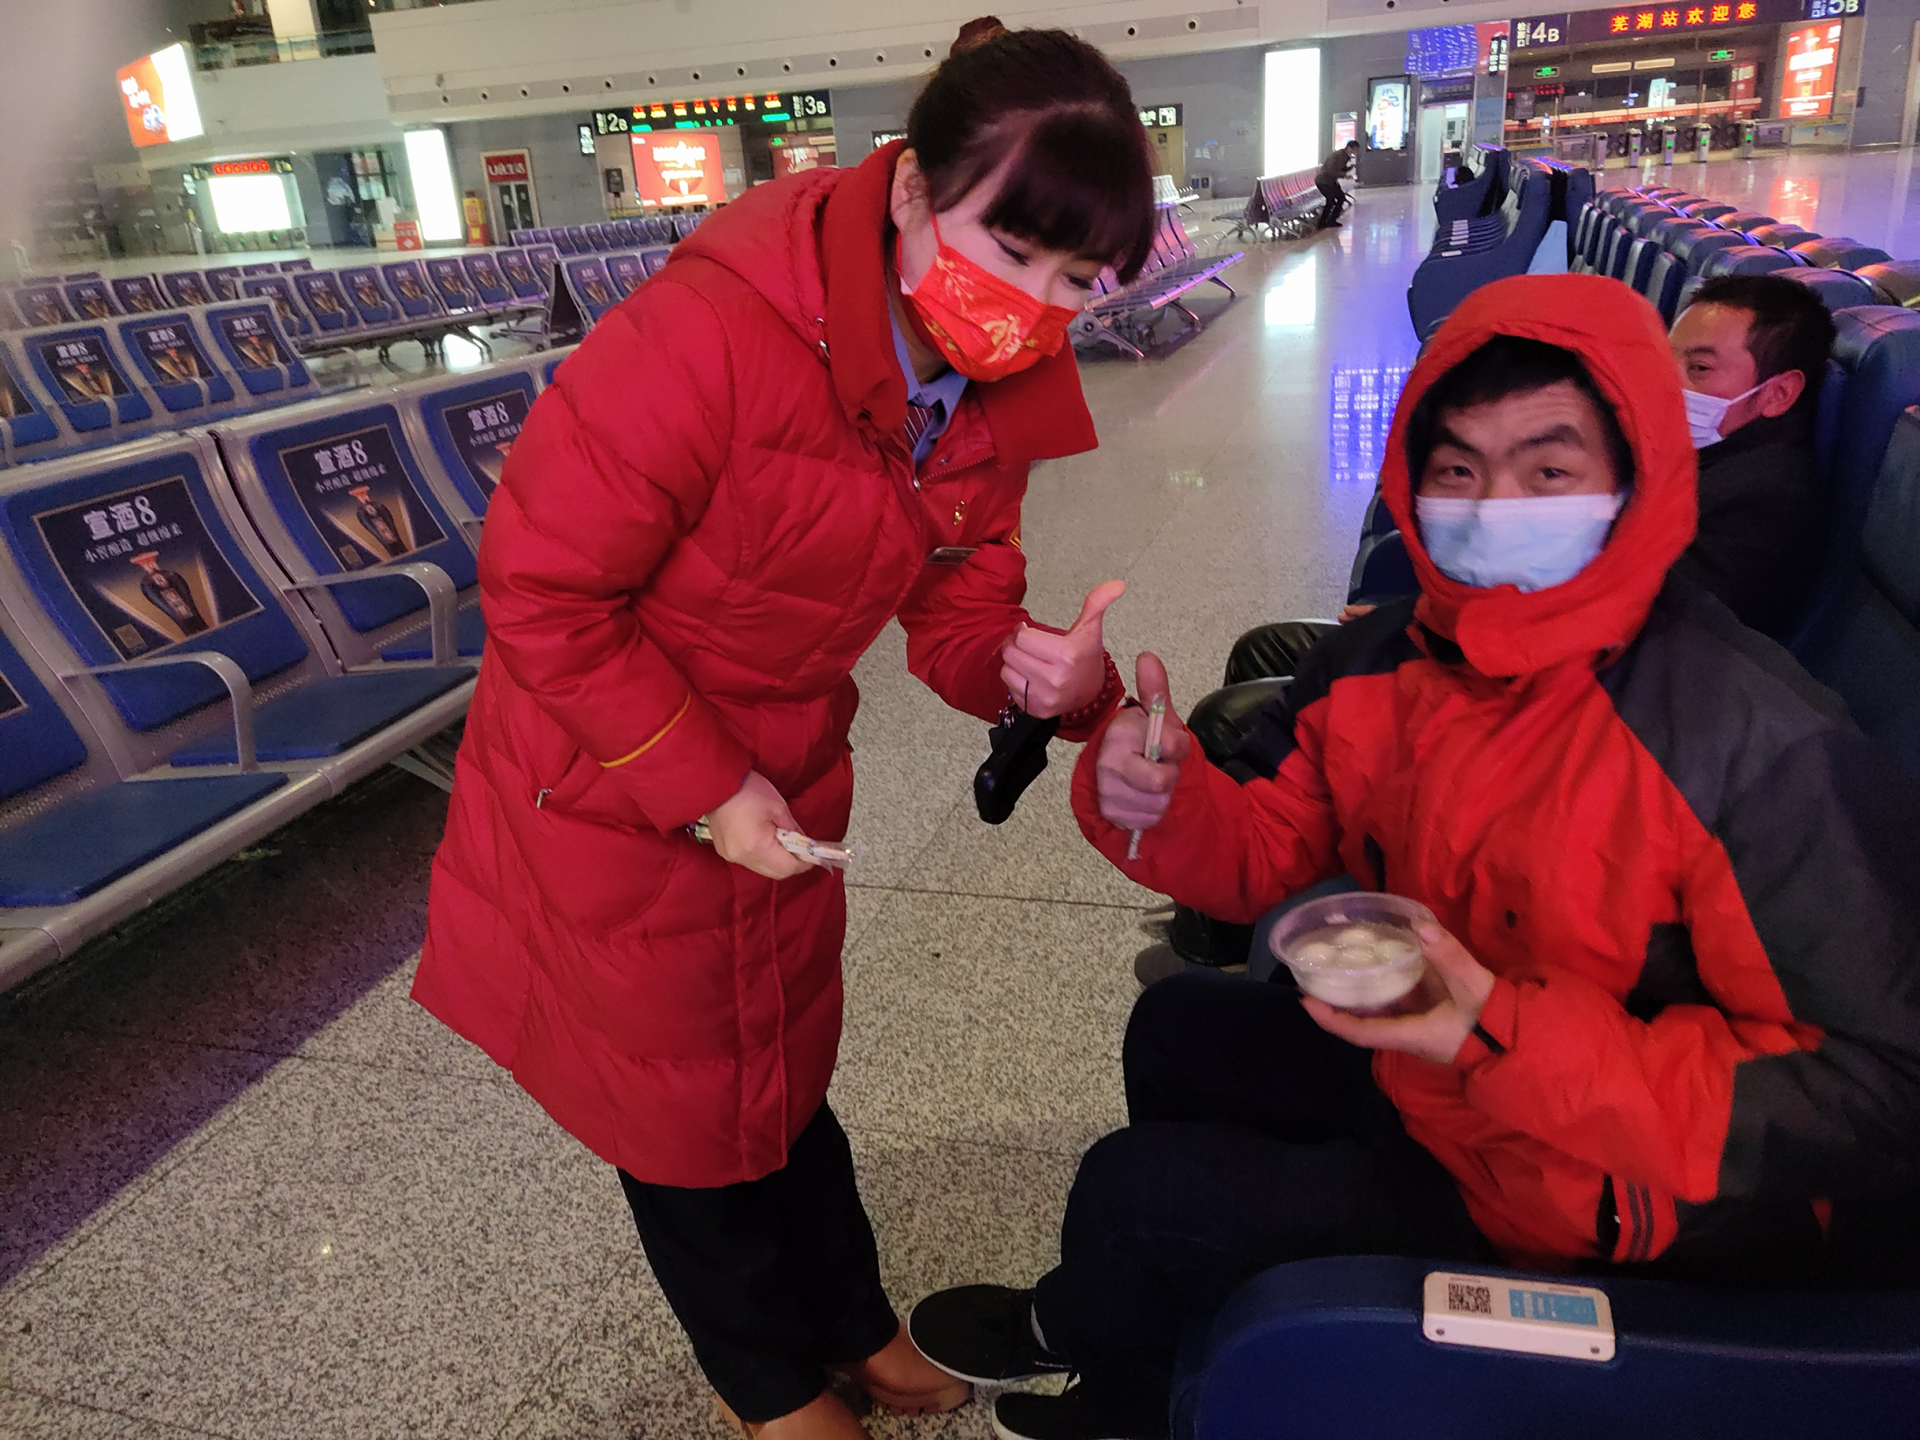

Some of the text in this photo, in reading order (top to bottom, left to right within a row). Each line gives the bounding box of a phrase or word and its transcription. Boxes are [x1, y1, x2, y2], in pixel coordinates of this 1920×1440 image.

[1611, 2, 1757, 33] 芜湖站欢迎您
[1531, 21, 1560, 43] 4B
[805, 95, 827, 115] 3B
[607, 112, 628, 132] 2B
[314, 439, 369, 475] 宣酒8
[83, 495, 158, 541] 宣酒8
